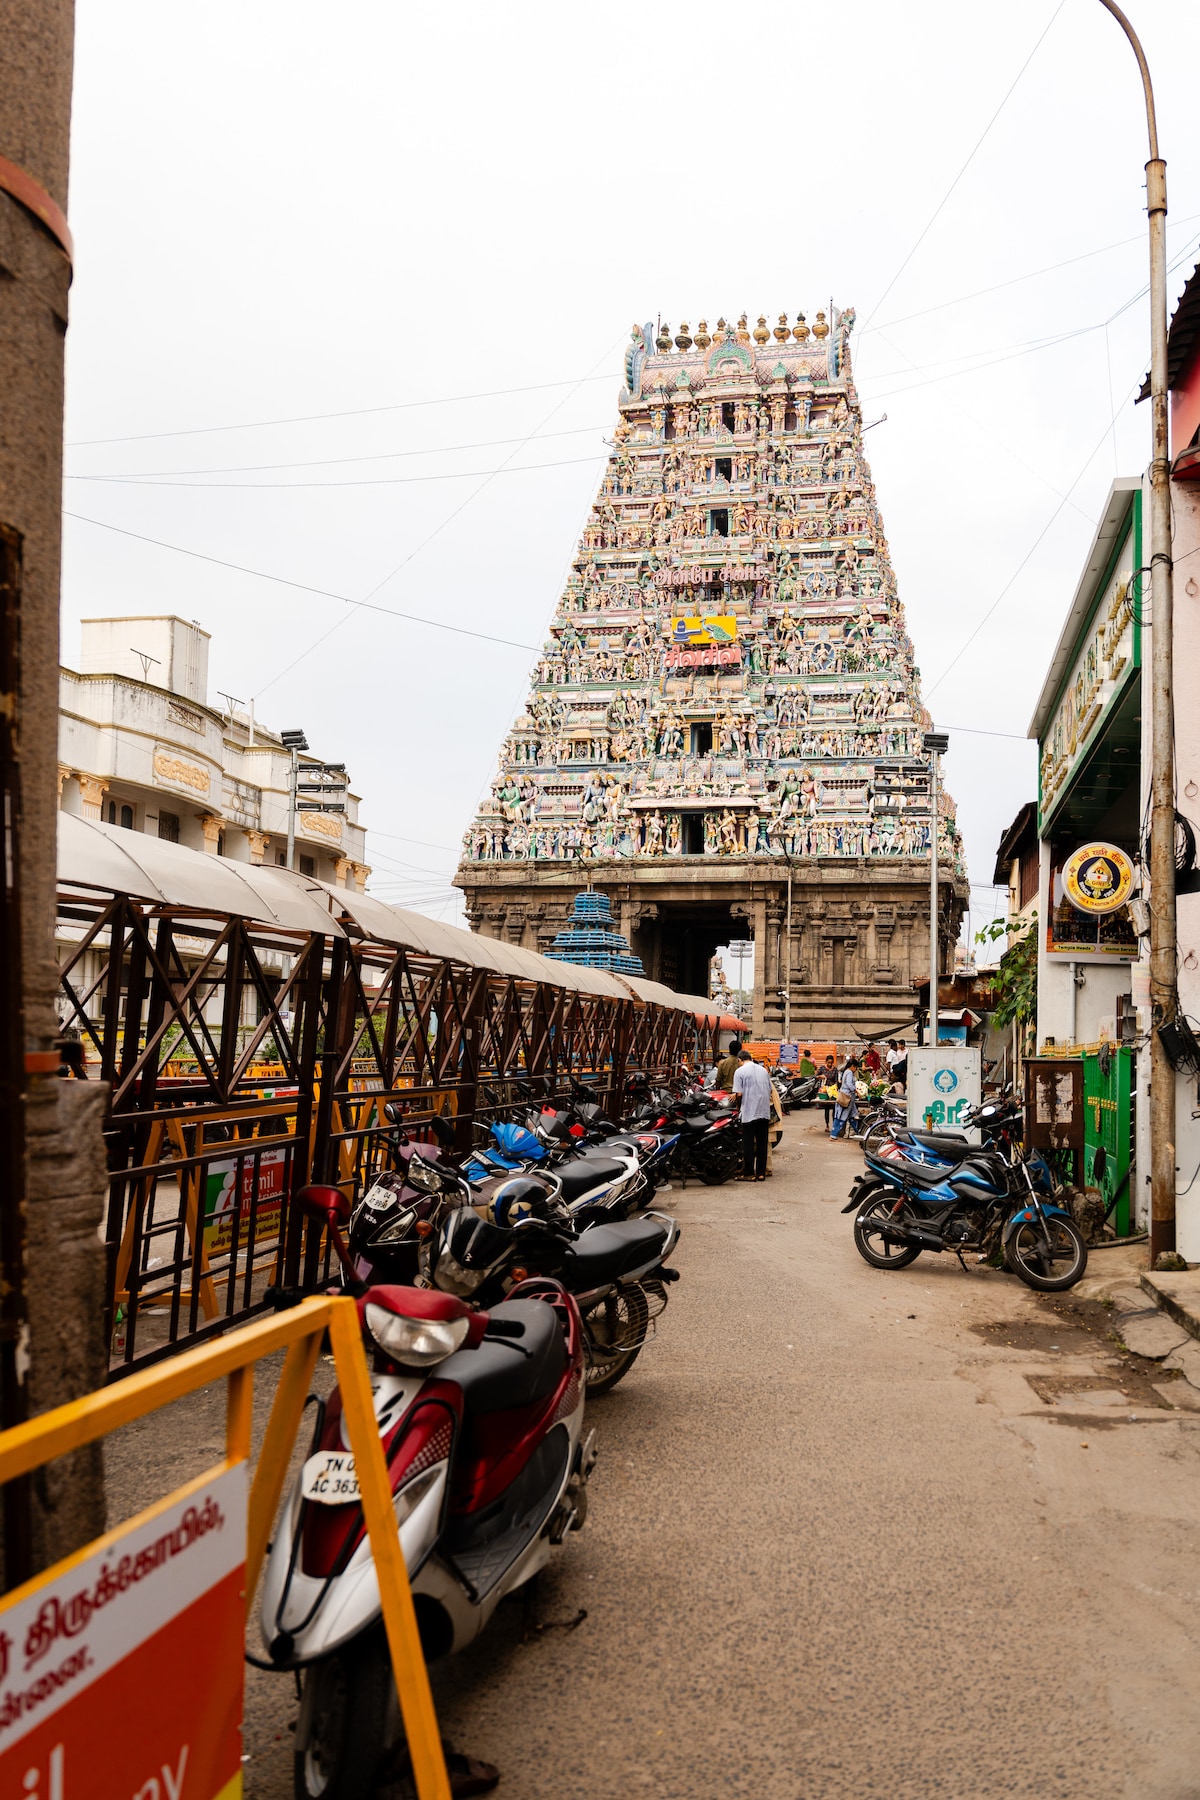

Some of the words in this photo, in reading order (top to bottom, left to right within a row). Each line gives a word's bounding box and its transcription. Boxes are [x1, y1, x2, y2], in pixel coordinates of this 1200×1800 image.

[326, 1458, 344, 1472] TN
[346, 1459, 357, 1472] 0
[310, 1479, 328, 1493] AC
[332, 1480, 361, 1494] 363
